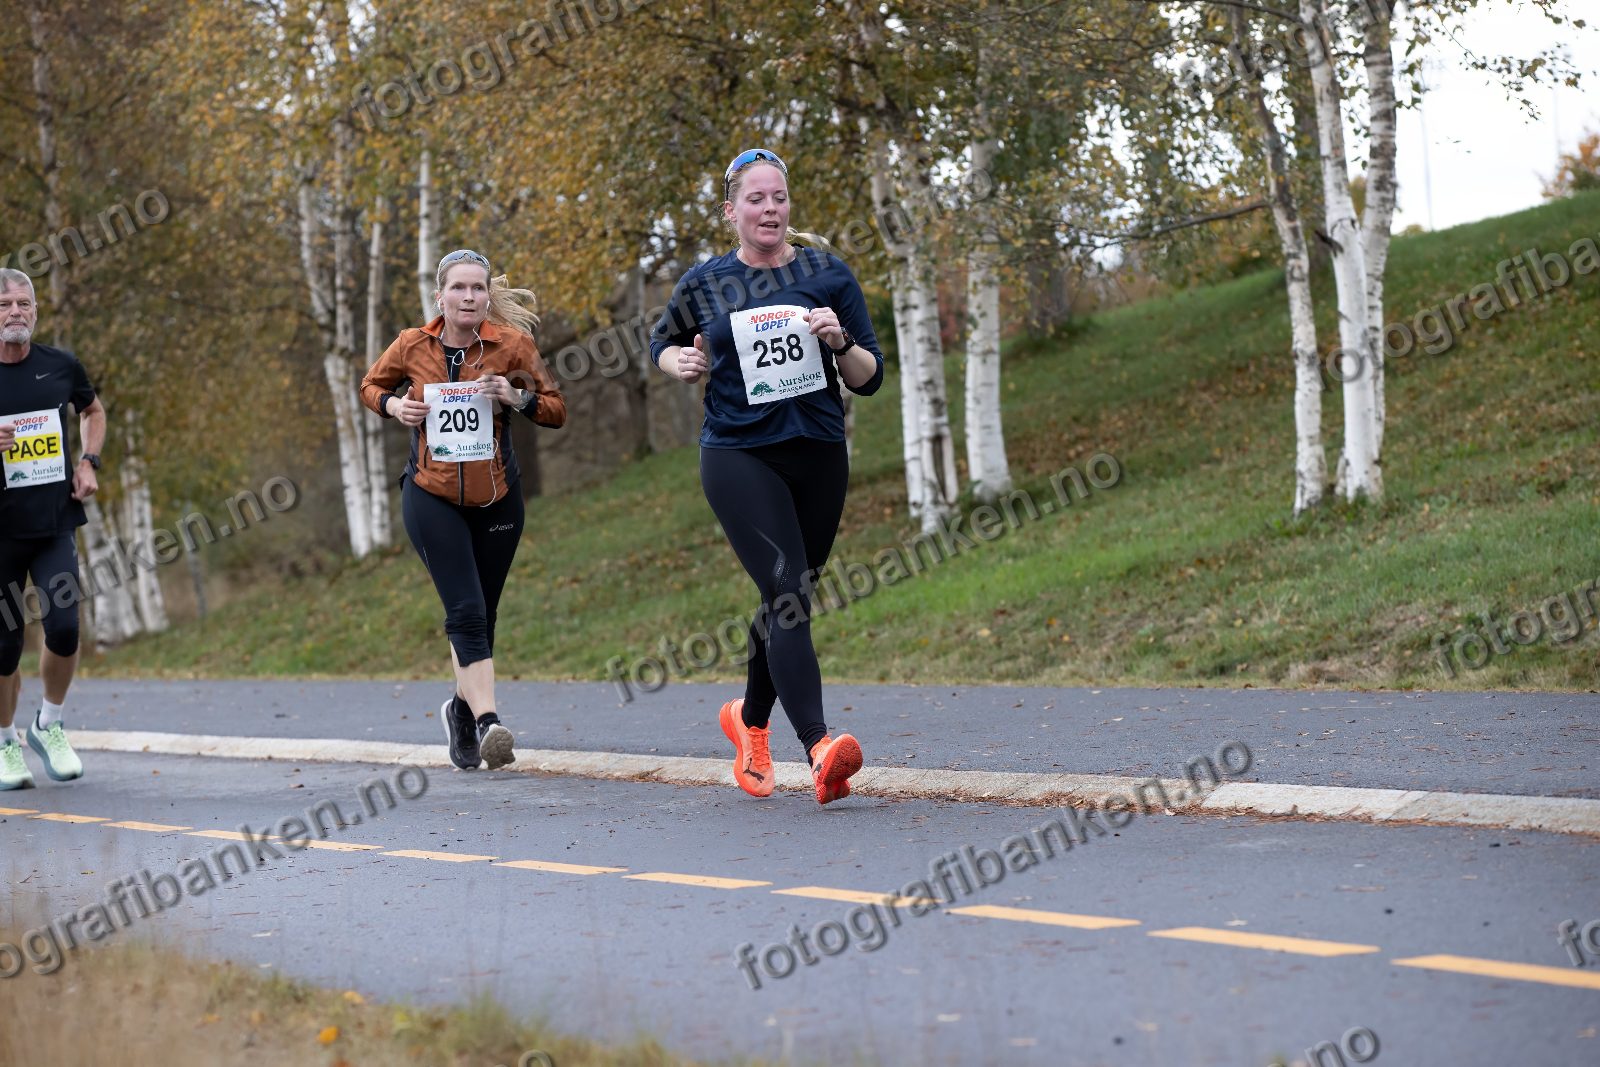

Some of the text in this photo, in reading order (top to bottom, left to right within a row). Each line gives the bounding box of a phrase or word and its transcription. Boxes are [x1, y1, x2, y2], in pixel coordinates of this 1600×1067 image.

[750, 310, 797, 324] NORGES
[755, 317, 791, 332] LØPET
[752, 333, 804, 368] 258
[778, 371, 822, 388] Aurskog
[439, 386, 479, 396] NORGES
[442, 394, 473, 404] LØPET
[13, 415, 49, 426] NORGES
[438, 407, 480, 433] 209
[16, 422, 44, 433] LØPET
[8, 436, 58, 460] PACE
[455, 441, 492, 452] Aurskog
[31, 465, 63, 477] Aurskog
